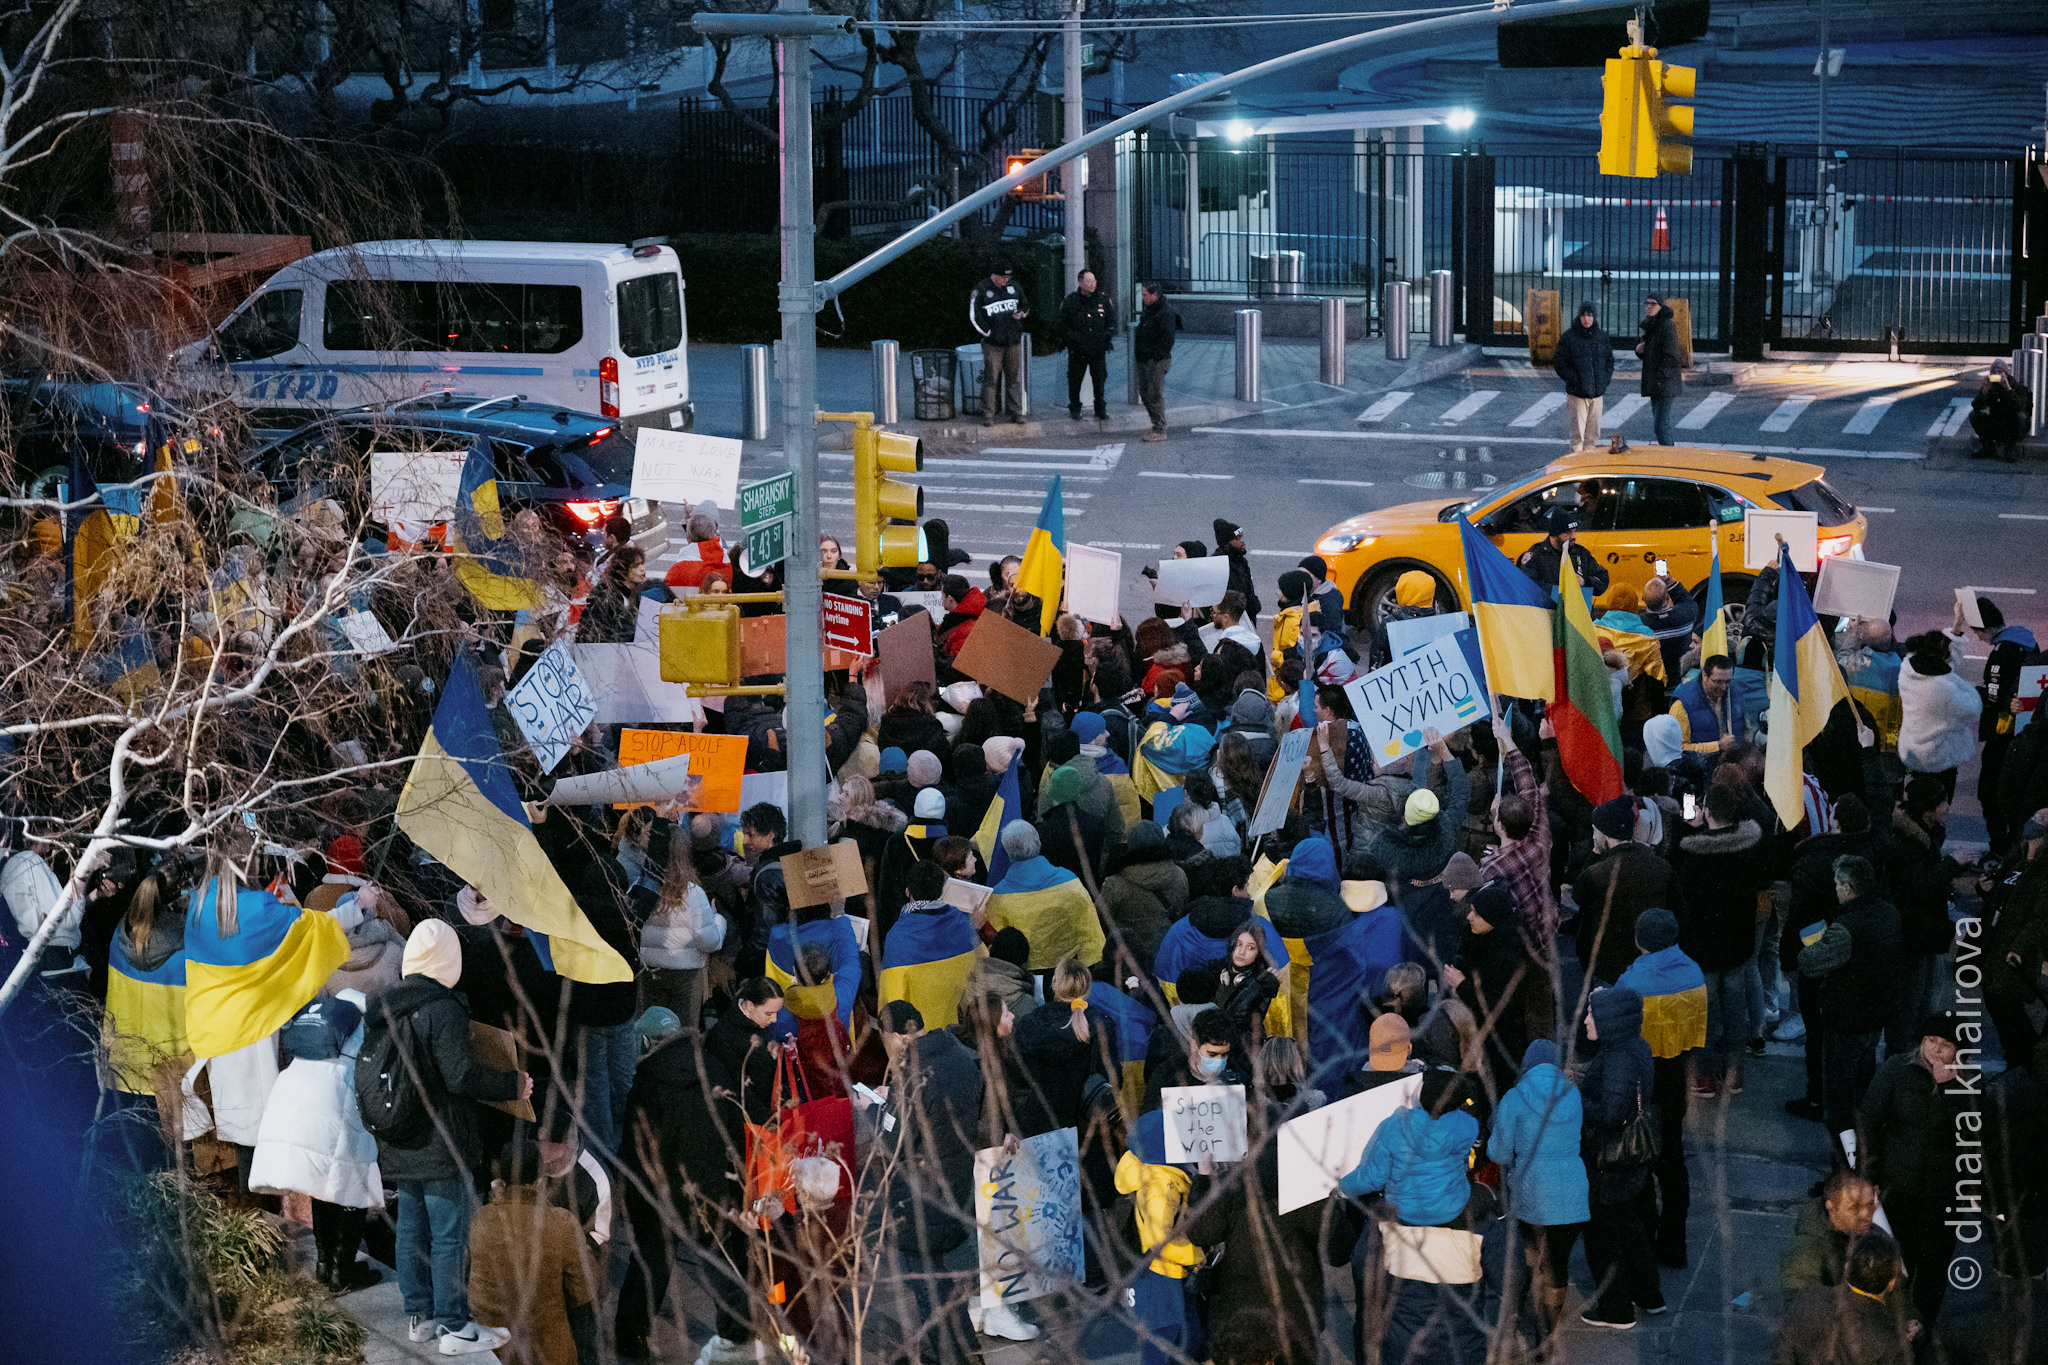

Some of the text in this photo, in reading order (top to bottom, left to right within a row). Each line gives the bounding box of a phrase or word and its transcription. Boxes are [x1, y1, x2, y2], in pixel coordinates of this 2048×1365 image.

[986, 302, 1017, 316] POLICE
[636, 356, 655, 369] NYPD
[249, 373, 338, 399] NYPD
[643, 437, 737, 458] MAKE LOVE
[641, 462, 722, 478] NOT WAR
[744, 479, 790, 512] SHARANSKY
[759, 504, 776, 518] STEPS
[750, 525, 781, 565] E 43 ST
[824, 598, 863, 616] NO STANDING
[825, 612, 849, 626] Anytime
[515, 649, 567, 723] STOP
[1361, 650, 1448, 711] ПУТІН
[1381, 673, 1469, 740] ХУЙЛО
[532, 684, 593, 759] WAR
[632, 732, 724, 754] STOP ADOLF
[1176, 1097, 1222, 1120] Stop
[1188, 1120, 1214, 1135] the
[1181, 1139, 1222, 1153] war
[989, 1160, 1029, 1298] NO WAR
